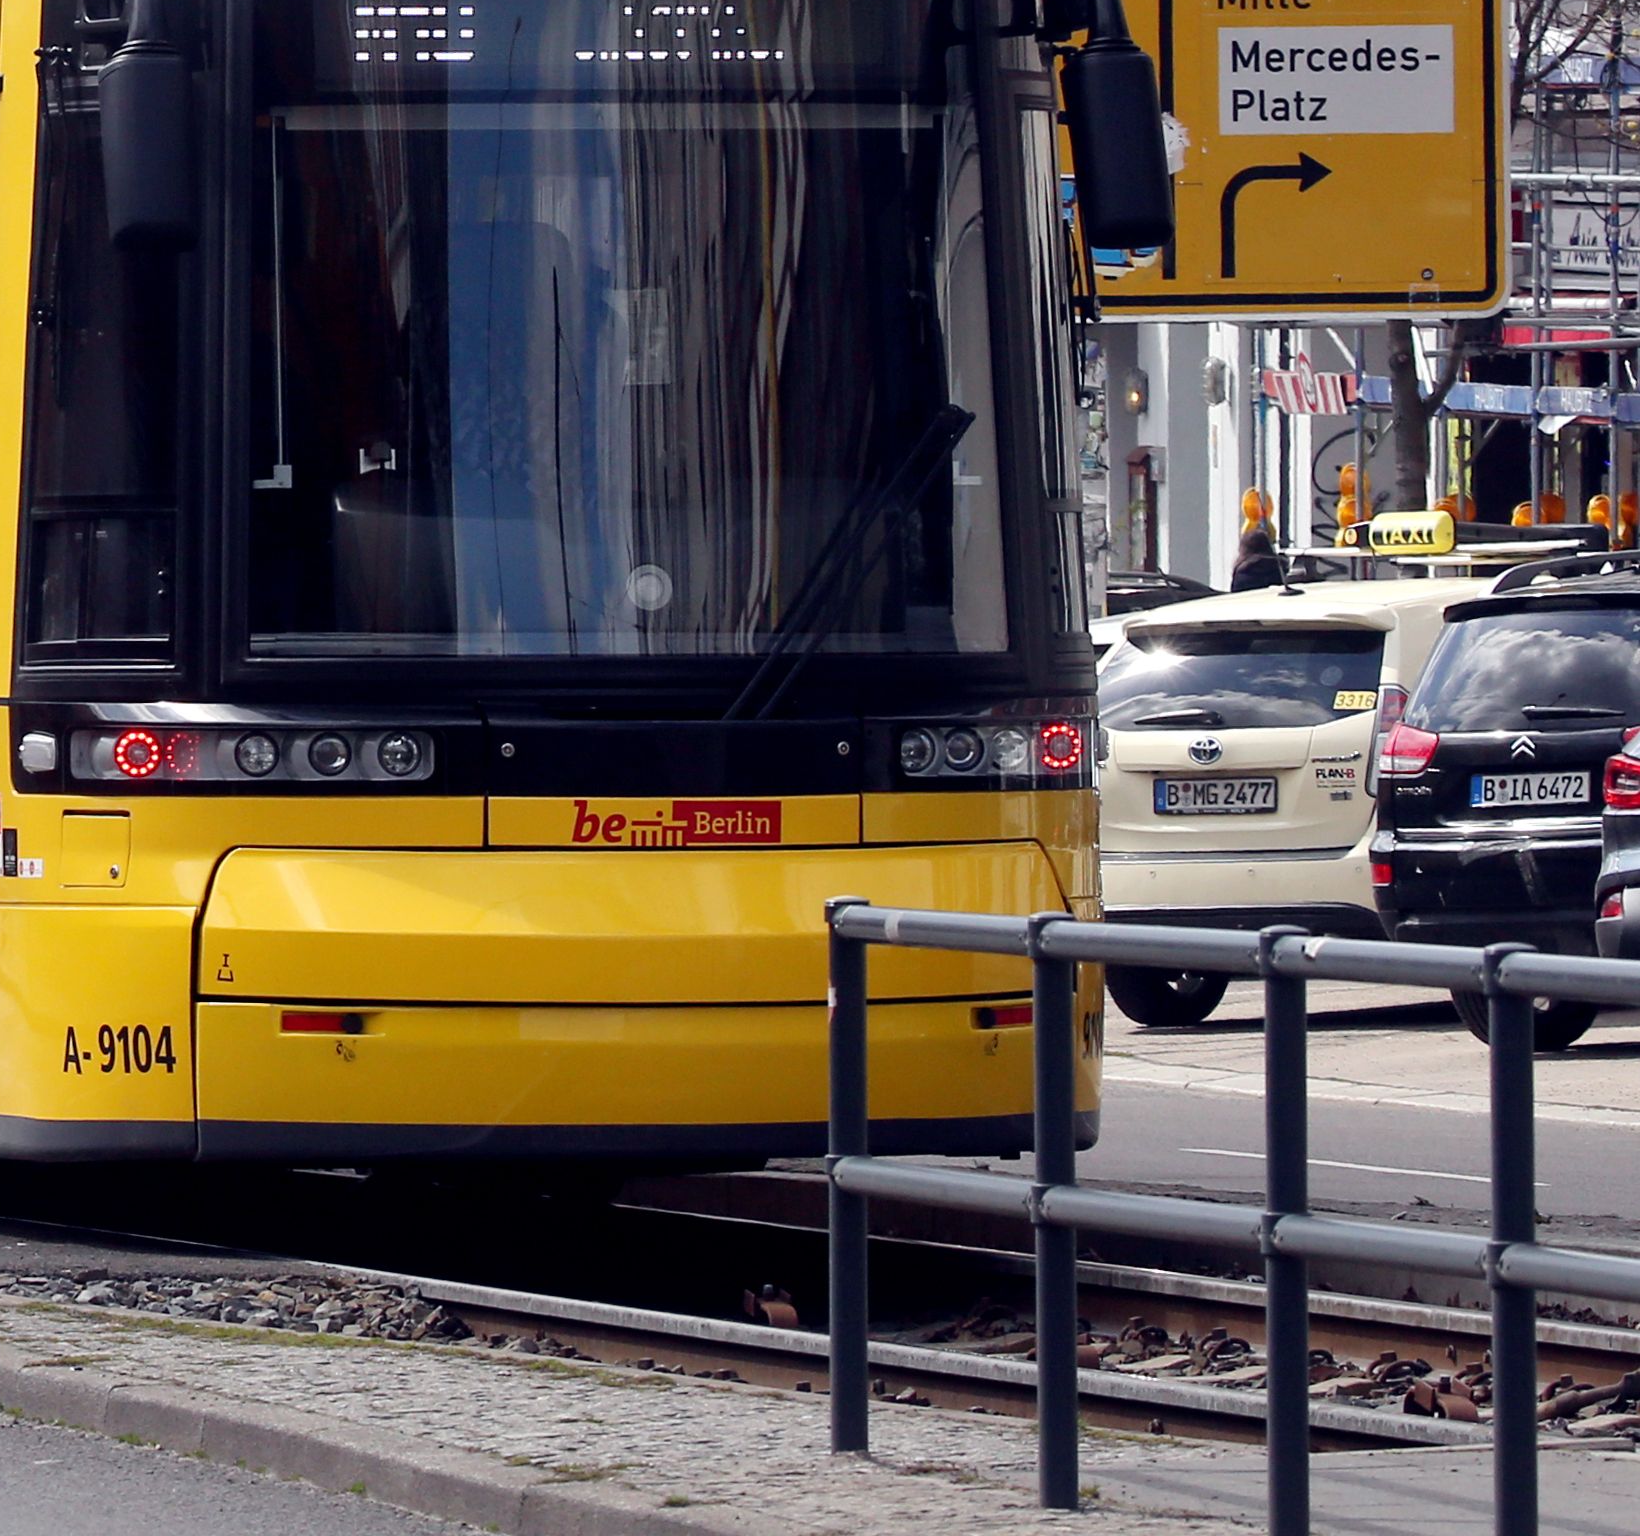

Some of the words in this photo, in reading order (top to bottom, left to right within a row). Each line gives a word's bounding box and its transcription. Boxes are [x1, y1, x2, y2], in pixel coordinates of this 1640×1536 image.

[1232, 39, 1440, 72] Mercedes-
[1232, 89, 1328, 121] Platz
[1375, 527, 1430, 545] TAXI
[1335, 693, 1375, 707] 3316
[1167, 785, 1179, 806] B
[1193, 783, 1219, 805] MG
[1224, 782, 1272, 805] 2477
[1483, 779, 1495, 801] B
[1509, 778, 1532, 800] IA
[1537, 776, 1584, 800] 6472
[572, 800, 627, 843] be
[694, 811, 771, 835] Berlin
[63, 1024, 176, 1074] A-9104
